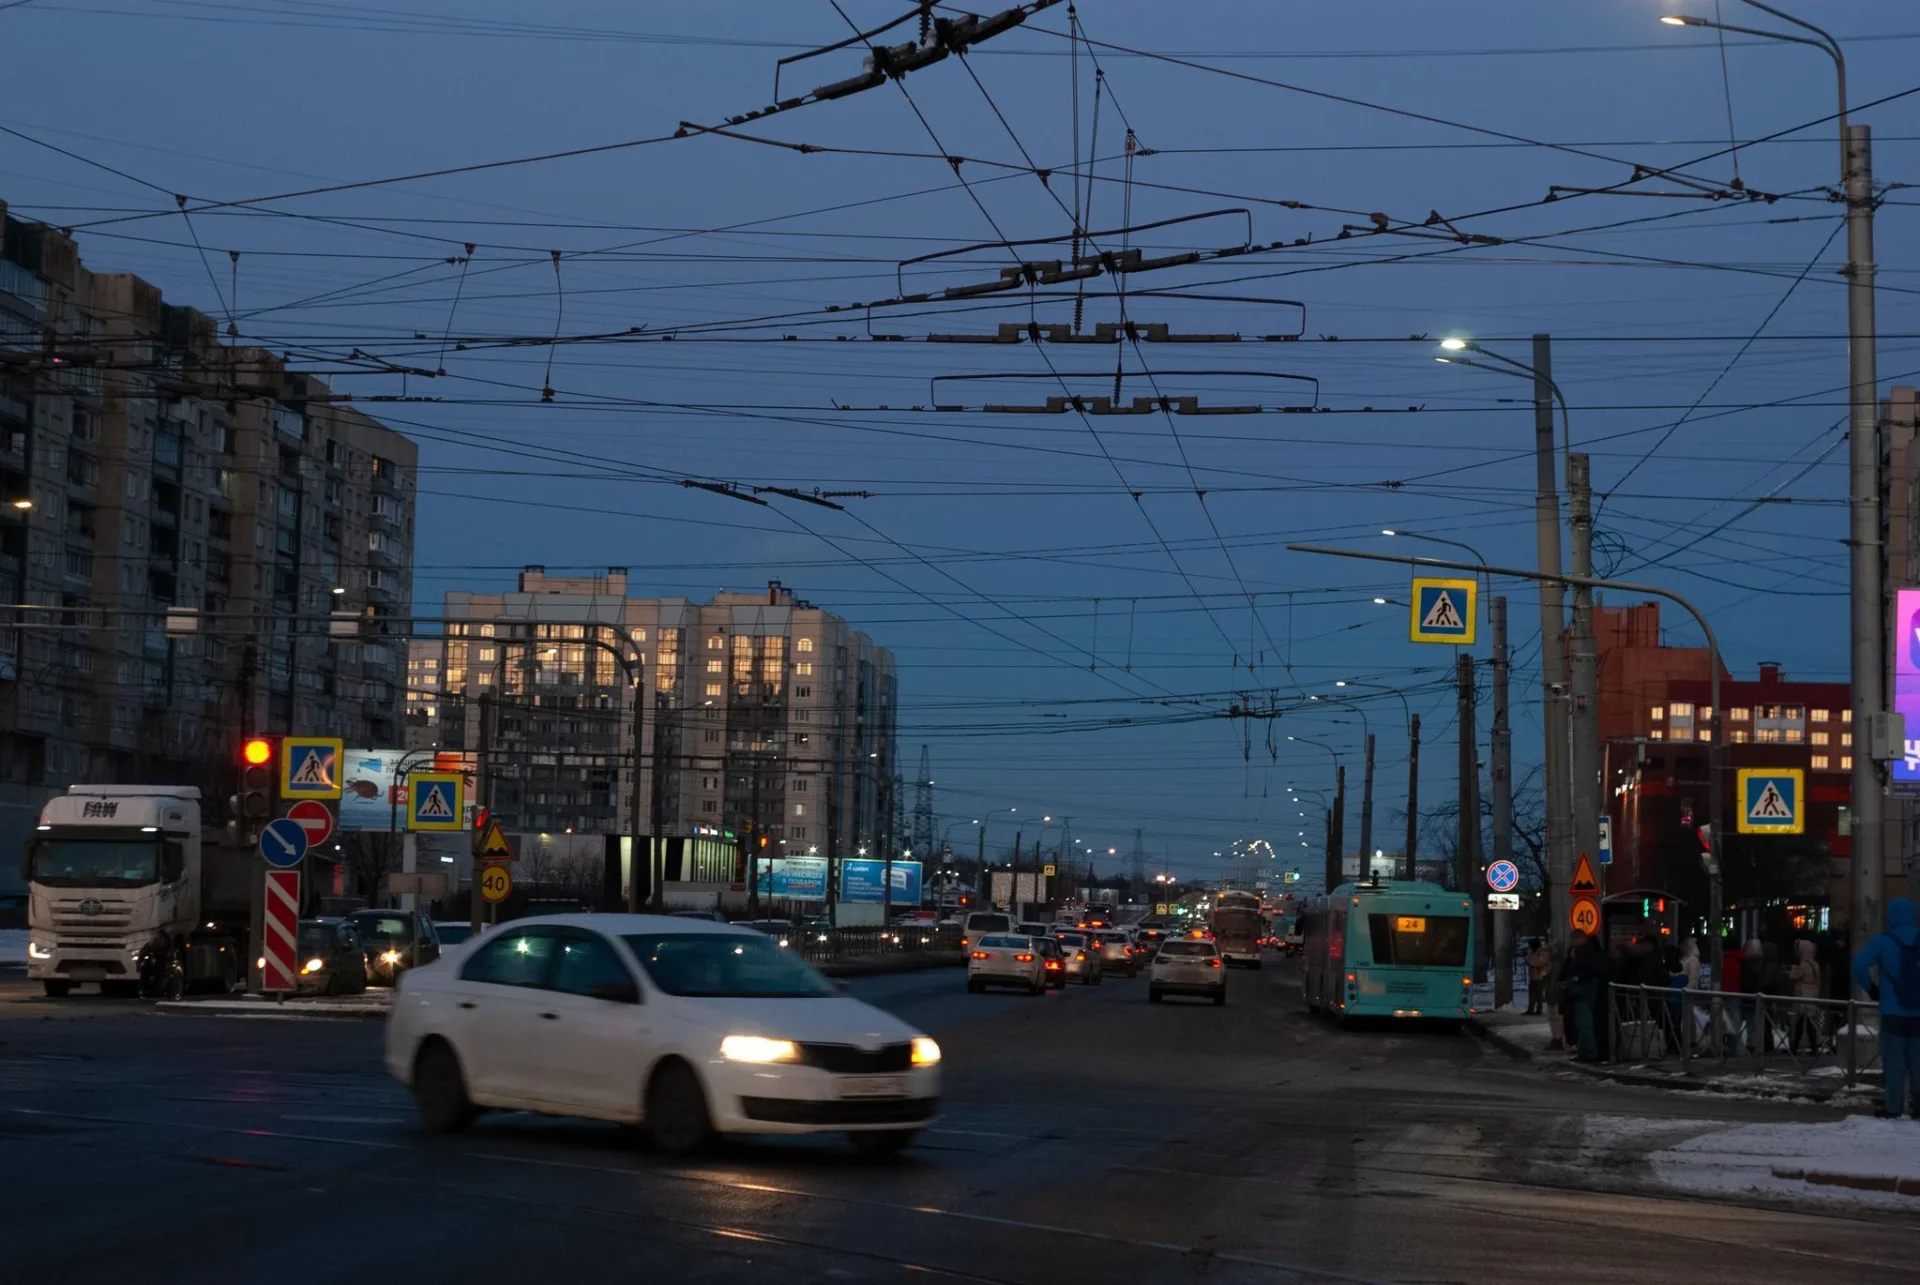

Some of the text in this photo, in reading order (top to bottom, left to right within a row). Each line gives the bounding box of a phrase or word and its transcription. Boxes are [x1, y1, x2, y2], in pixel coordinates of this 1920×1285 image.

[82, 802, 119, 818] FAW
[481, 876, 504, 891] 40
[788, 878, 822, 886] ПОДАРОК
[1405, 920, 1418, 929] 24
[1577, 910, 1594, 925] 40
